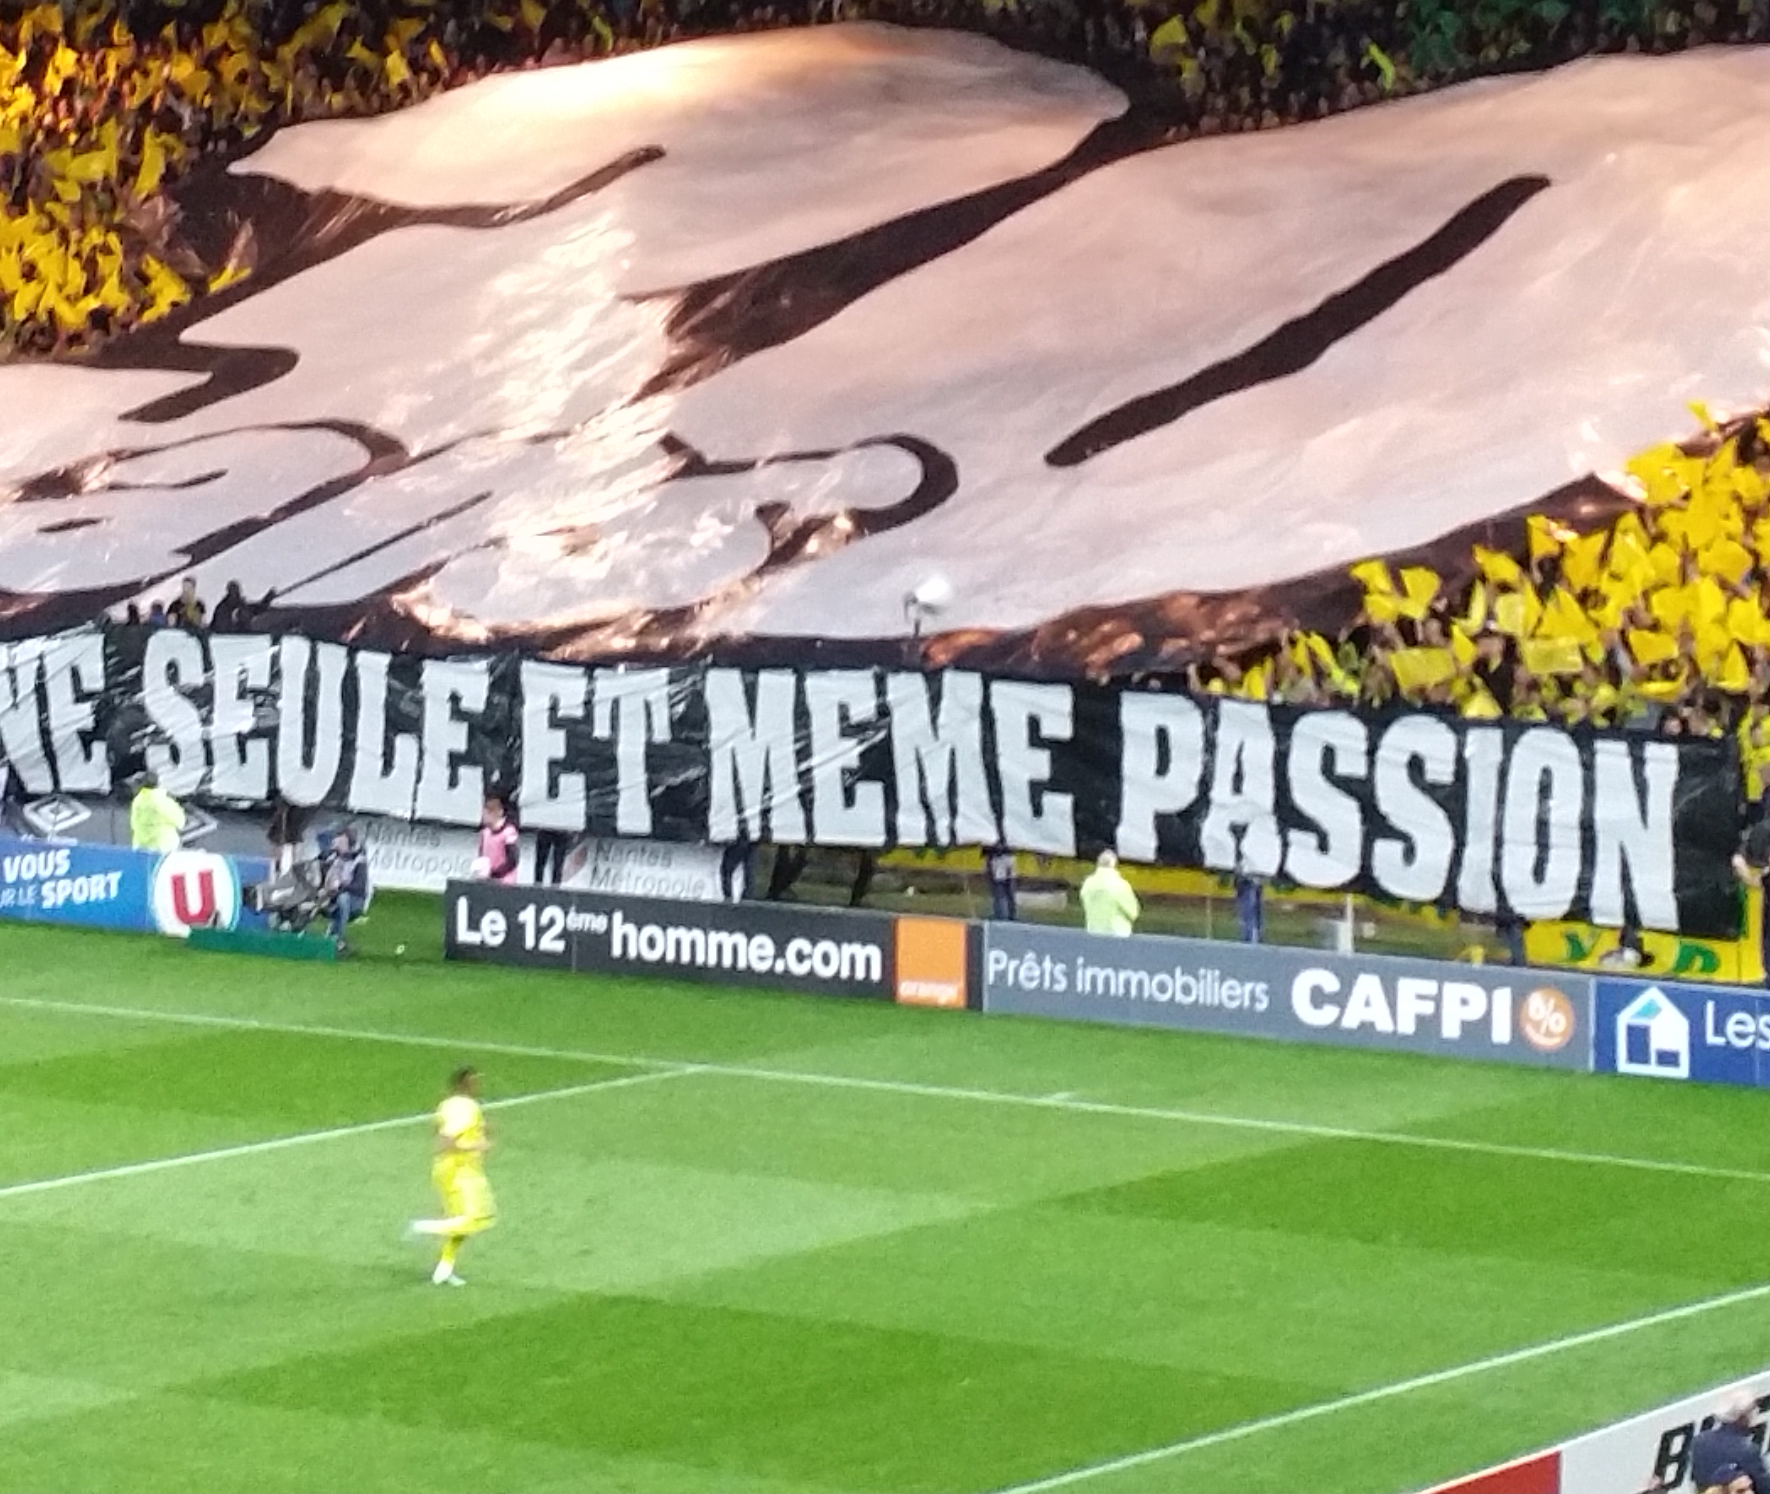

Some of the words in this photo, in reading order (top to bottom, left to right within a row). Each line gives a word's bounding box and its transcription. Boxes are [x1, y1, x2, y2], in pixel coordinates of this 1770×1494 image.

[143, 629, 489, 826] SEULE
[517, 661, 671, 836] ET
[705, 666, 1077, 857] MEME
[1115, 689, 1679, 932] PASSION
[3, 848, 71, 880] VOUS
[41, 870, 123, 910] SPORT
[456, 896, 508, 946] Le
[610, 909, 882, 984] homme.com
[987, 949, 1068, 993] Prêts
[1075, 956, 1270, 1013] immobiliers
[1291, 967, 1513, 1045] CAFPI
